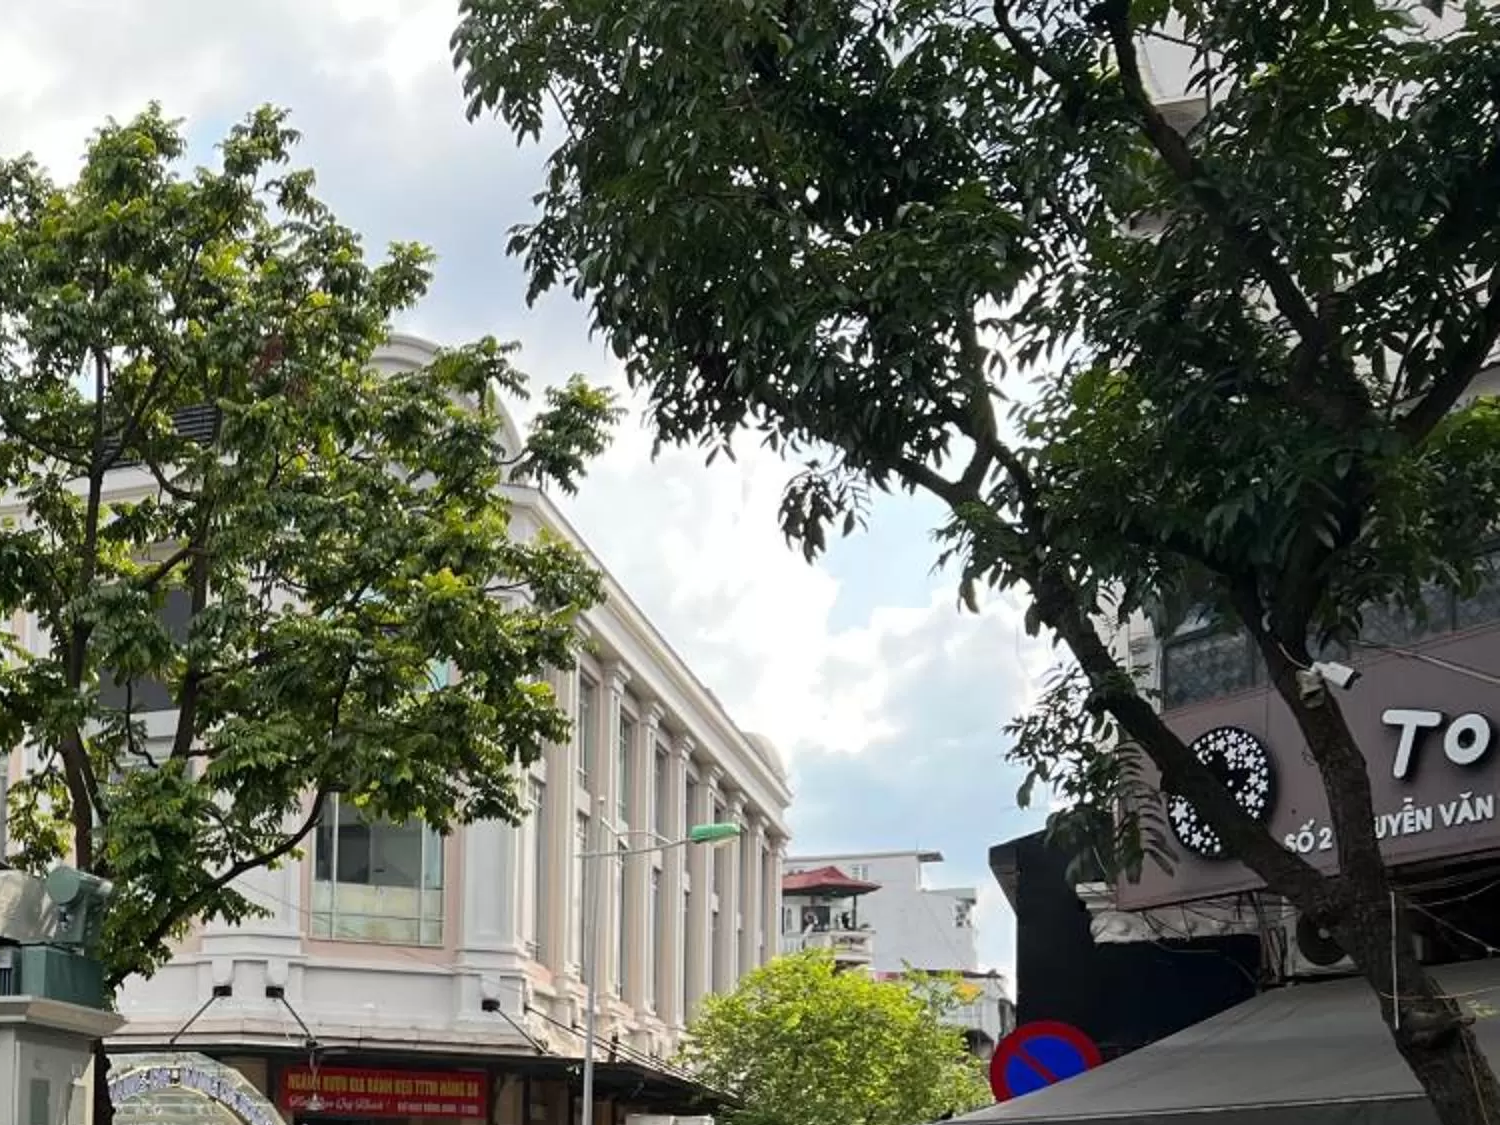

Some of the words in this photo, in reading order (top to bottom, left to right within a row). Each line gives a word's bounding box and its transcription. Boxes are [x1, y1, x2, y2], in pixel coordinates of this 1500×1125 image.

[1382, 709, 1490, 779] TO
[1284, 818, 1315, 853] SỐ
[1373, 797, 1433, 839] UYỄN
[1439, 791, 1494, 827] VĂN
